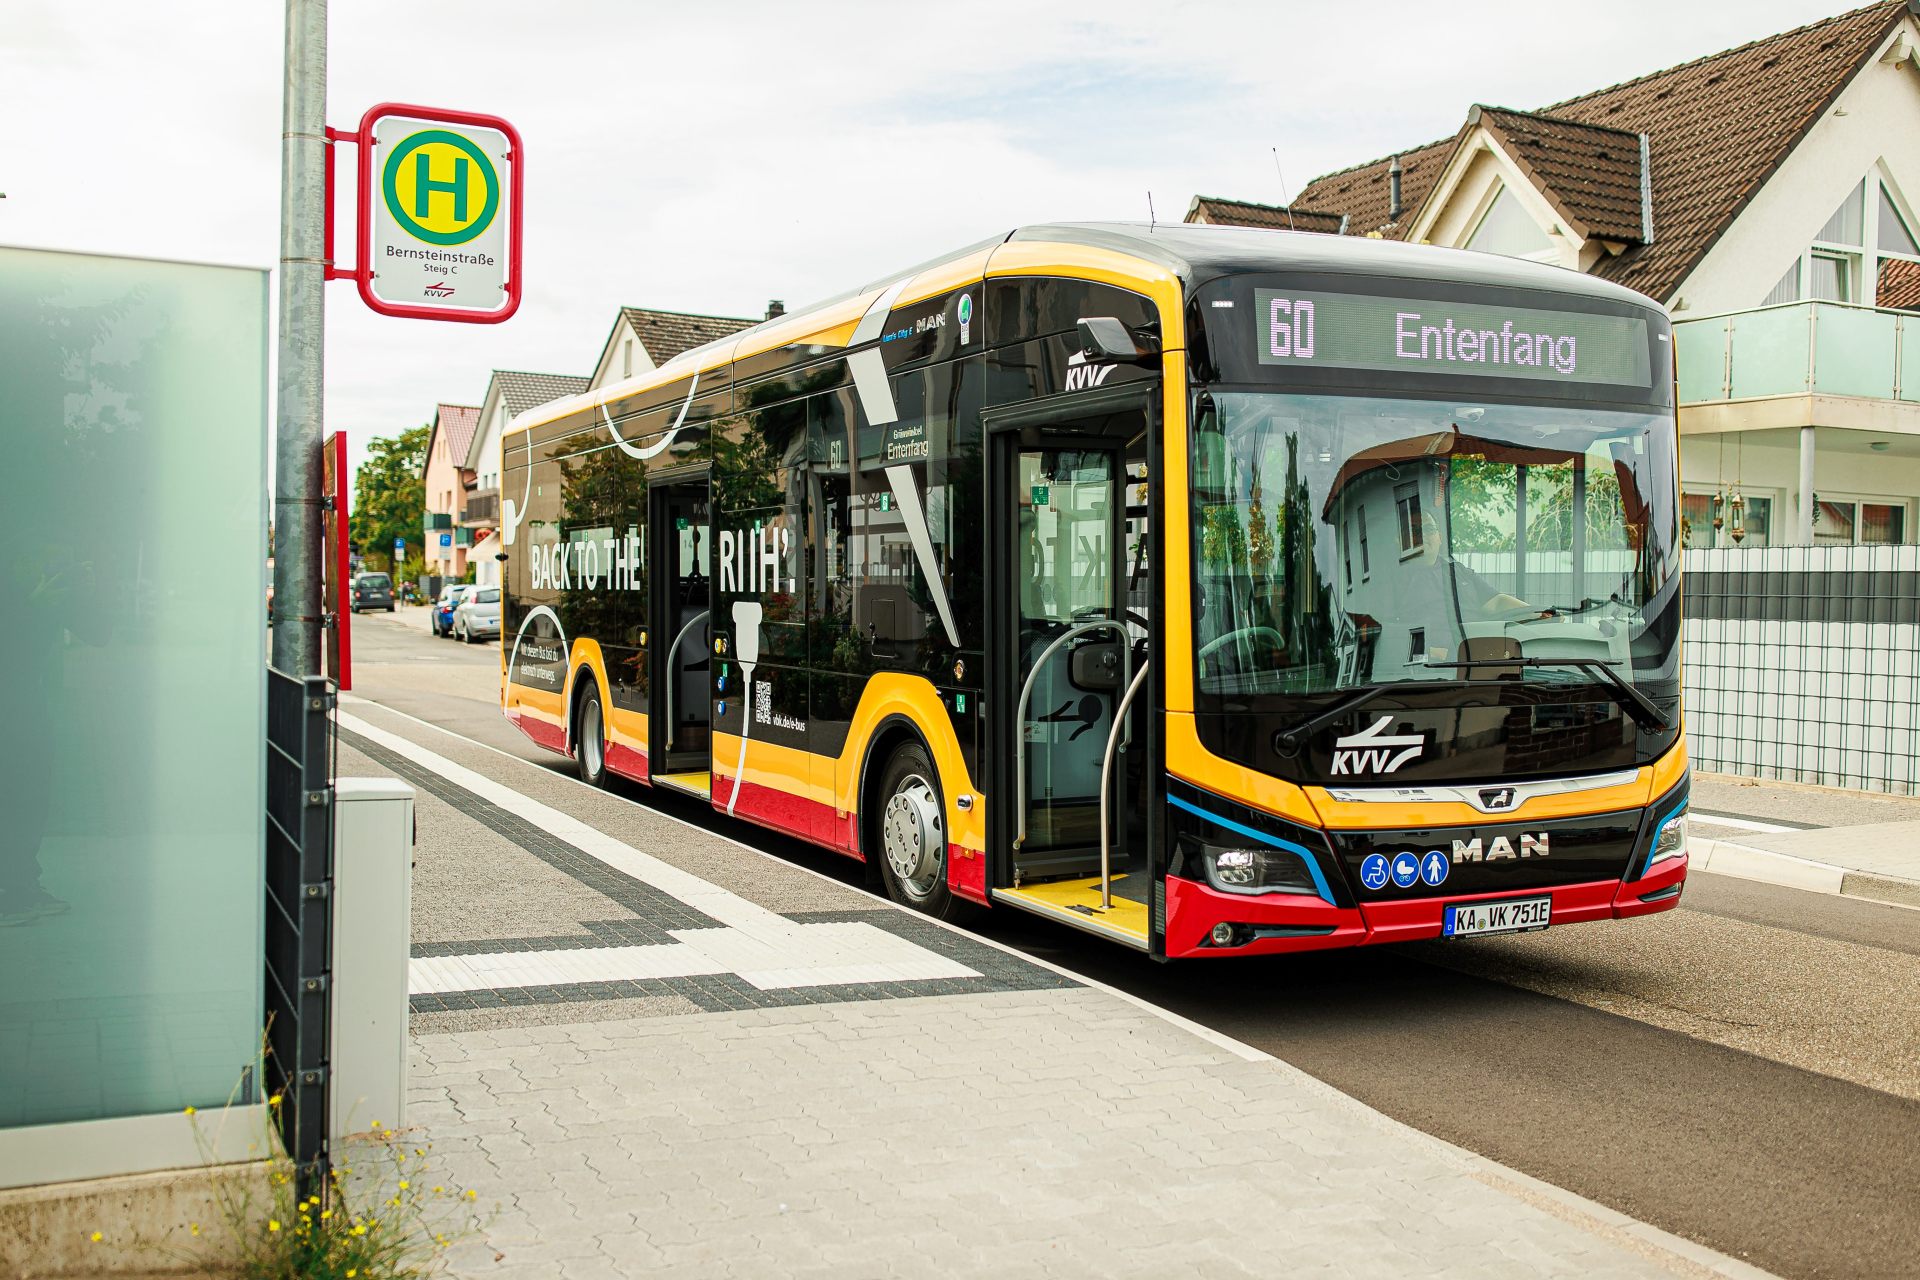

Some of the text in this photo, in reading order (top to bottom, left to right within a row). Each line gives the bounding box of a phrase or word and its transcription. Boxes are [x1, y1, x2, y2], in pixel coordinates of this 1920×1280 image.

[416, 153, 469, 222] H
[386, 245, 494, 266] Bernsteinstraße
[424, 263, 458, 275] Steig C
[916, 312, 946, 334] MAN
[1270, 298, 1576, 374] 60 Entenfang
[1065, 364, 1098, 391] KVV
[830, 440, 842, 470] 60
[887, 439, 929, 460] Entenfang
[531, 541, 571, 591] BACK
[575, 539, 599, 591] TO
[603, 536, 641, 591] THE
[773, 714, 806, 732] vbk.de/e-bus
[1331, 749, 1391, 775] KVV
[1452, 832, 1550, 864] MAN
[1457, 901, 1549, 931] KA VK 751E
